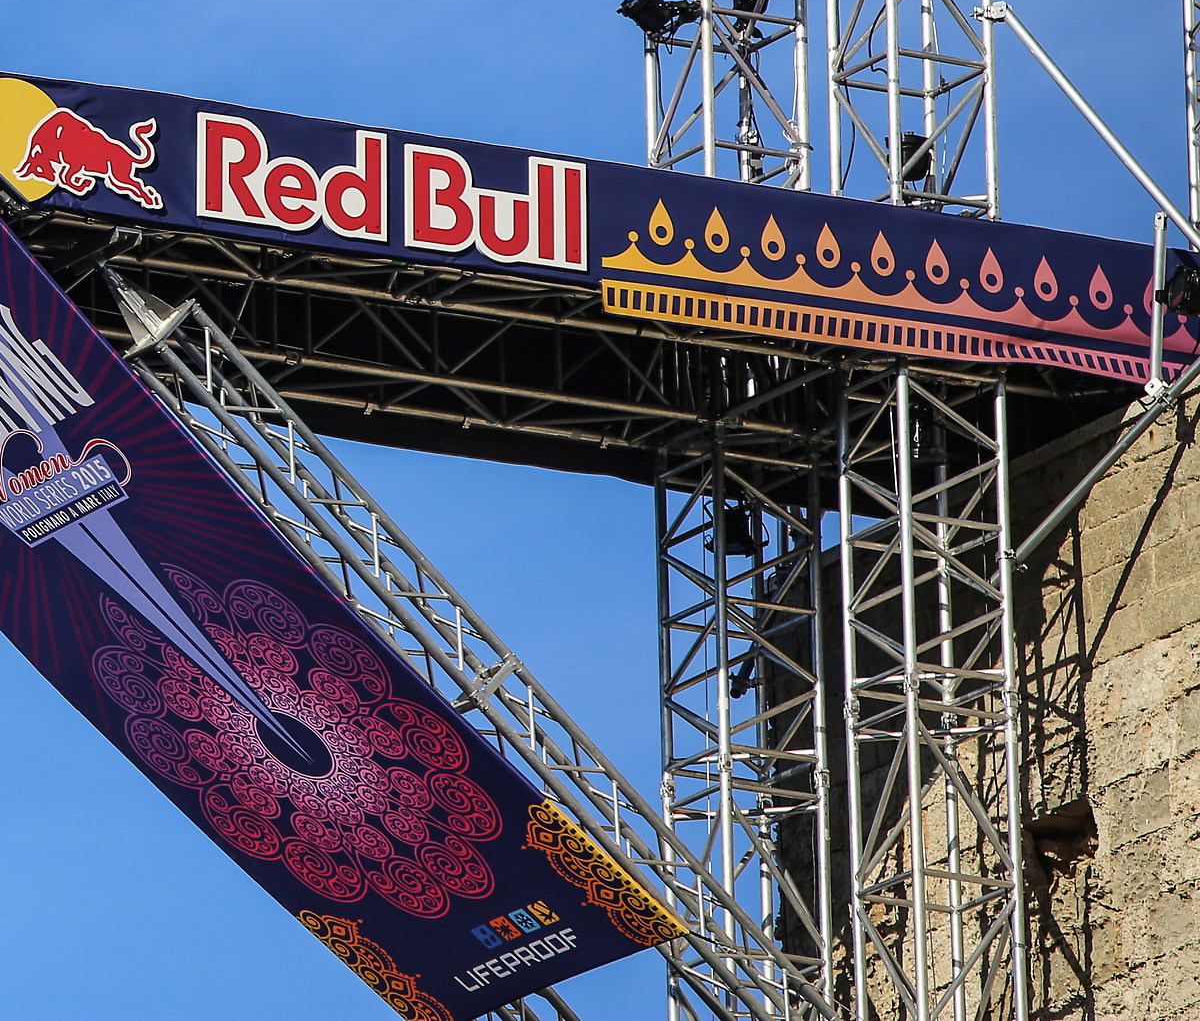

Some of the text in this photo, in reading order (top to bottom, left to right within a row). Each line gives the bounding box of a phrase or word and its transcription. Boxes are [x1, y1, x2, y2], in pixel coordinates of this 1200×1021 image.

[197, 112, 587, 271] Red Bull
[22, 484, 120, 542] POLIGNANO A MARE ITALY
[34, 477, 79, 510] SERIES
[71, 459, 112, 491] 2015
[454, 928, 577, 992] LIFEPROOF
